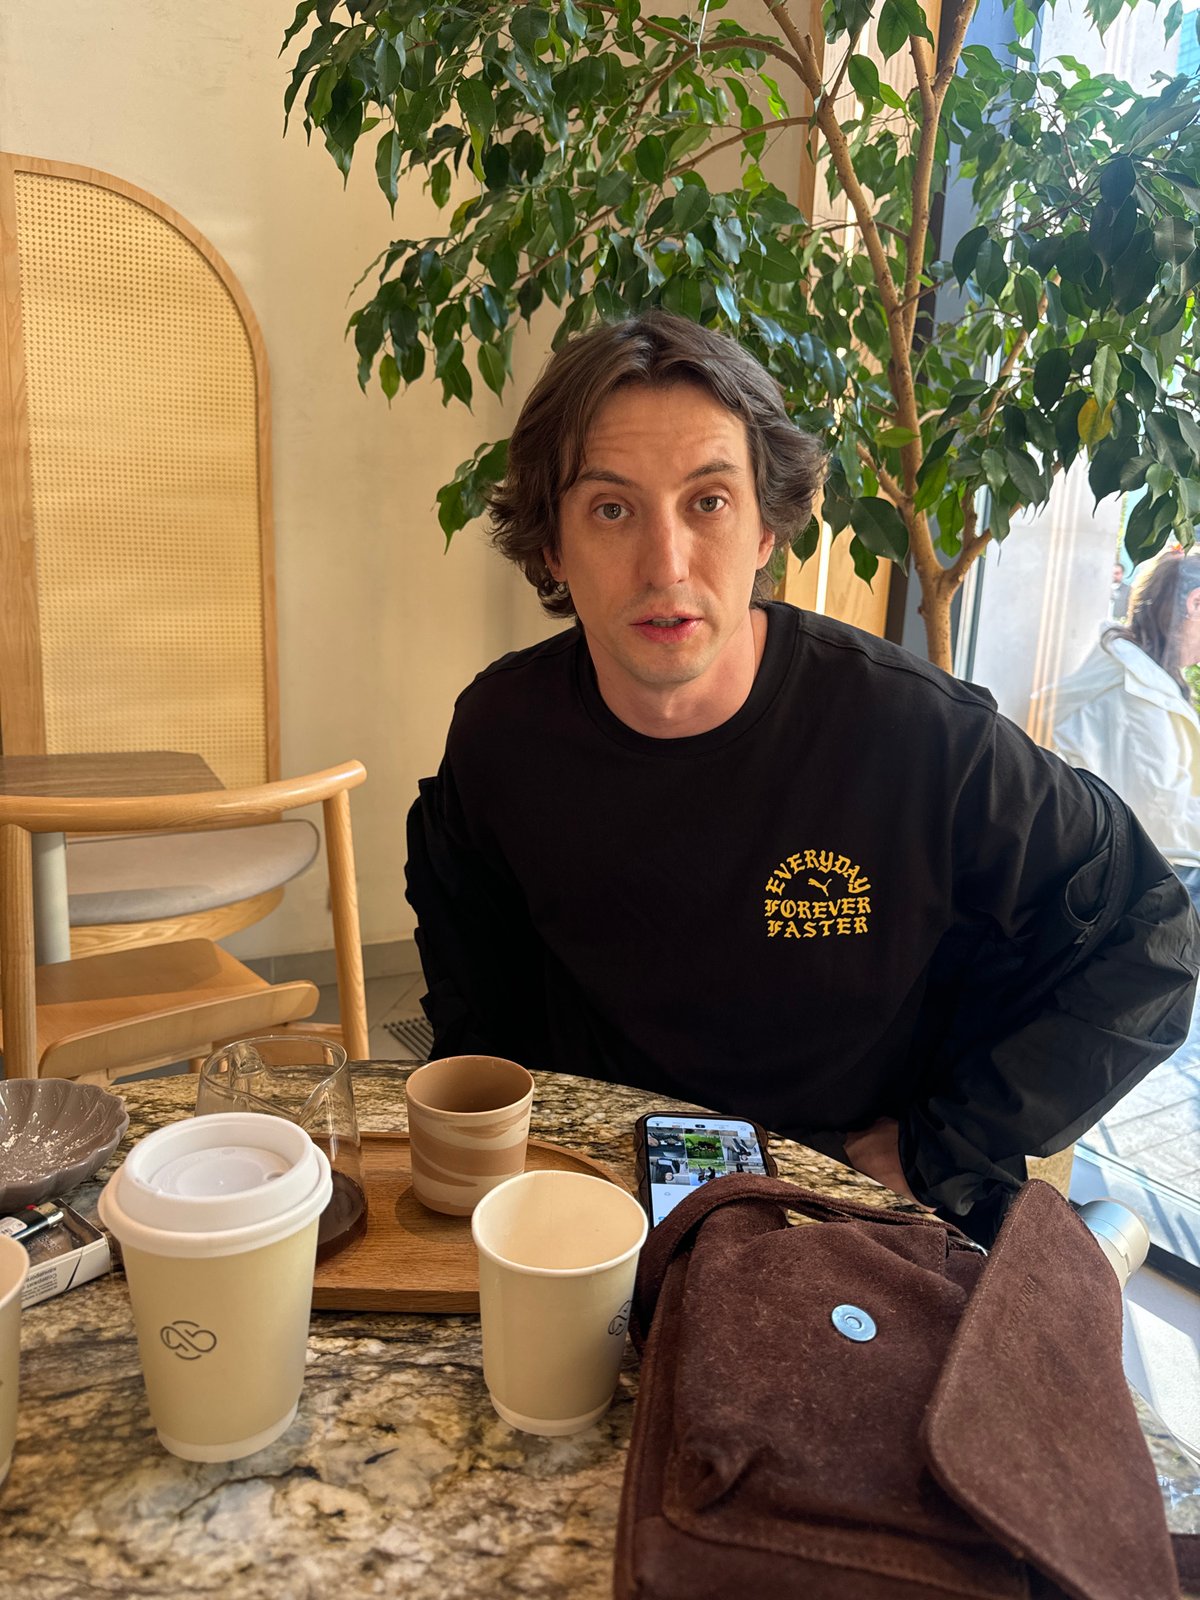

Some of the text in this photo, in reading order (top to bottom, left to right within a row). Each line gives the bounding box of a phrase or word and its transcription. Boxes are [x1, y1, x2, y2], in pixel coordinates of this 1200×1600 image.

[765, 849, 872, 896] EVERYDAY
[764, 896, 872, 919] FOREVER
[767, 916, 869, 939] FASTER
